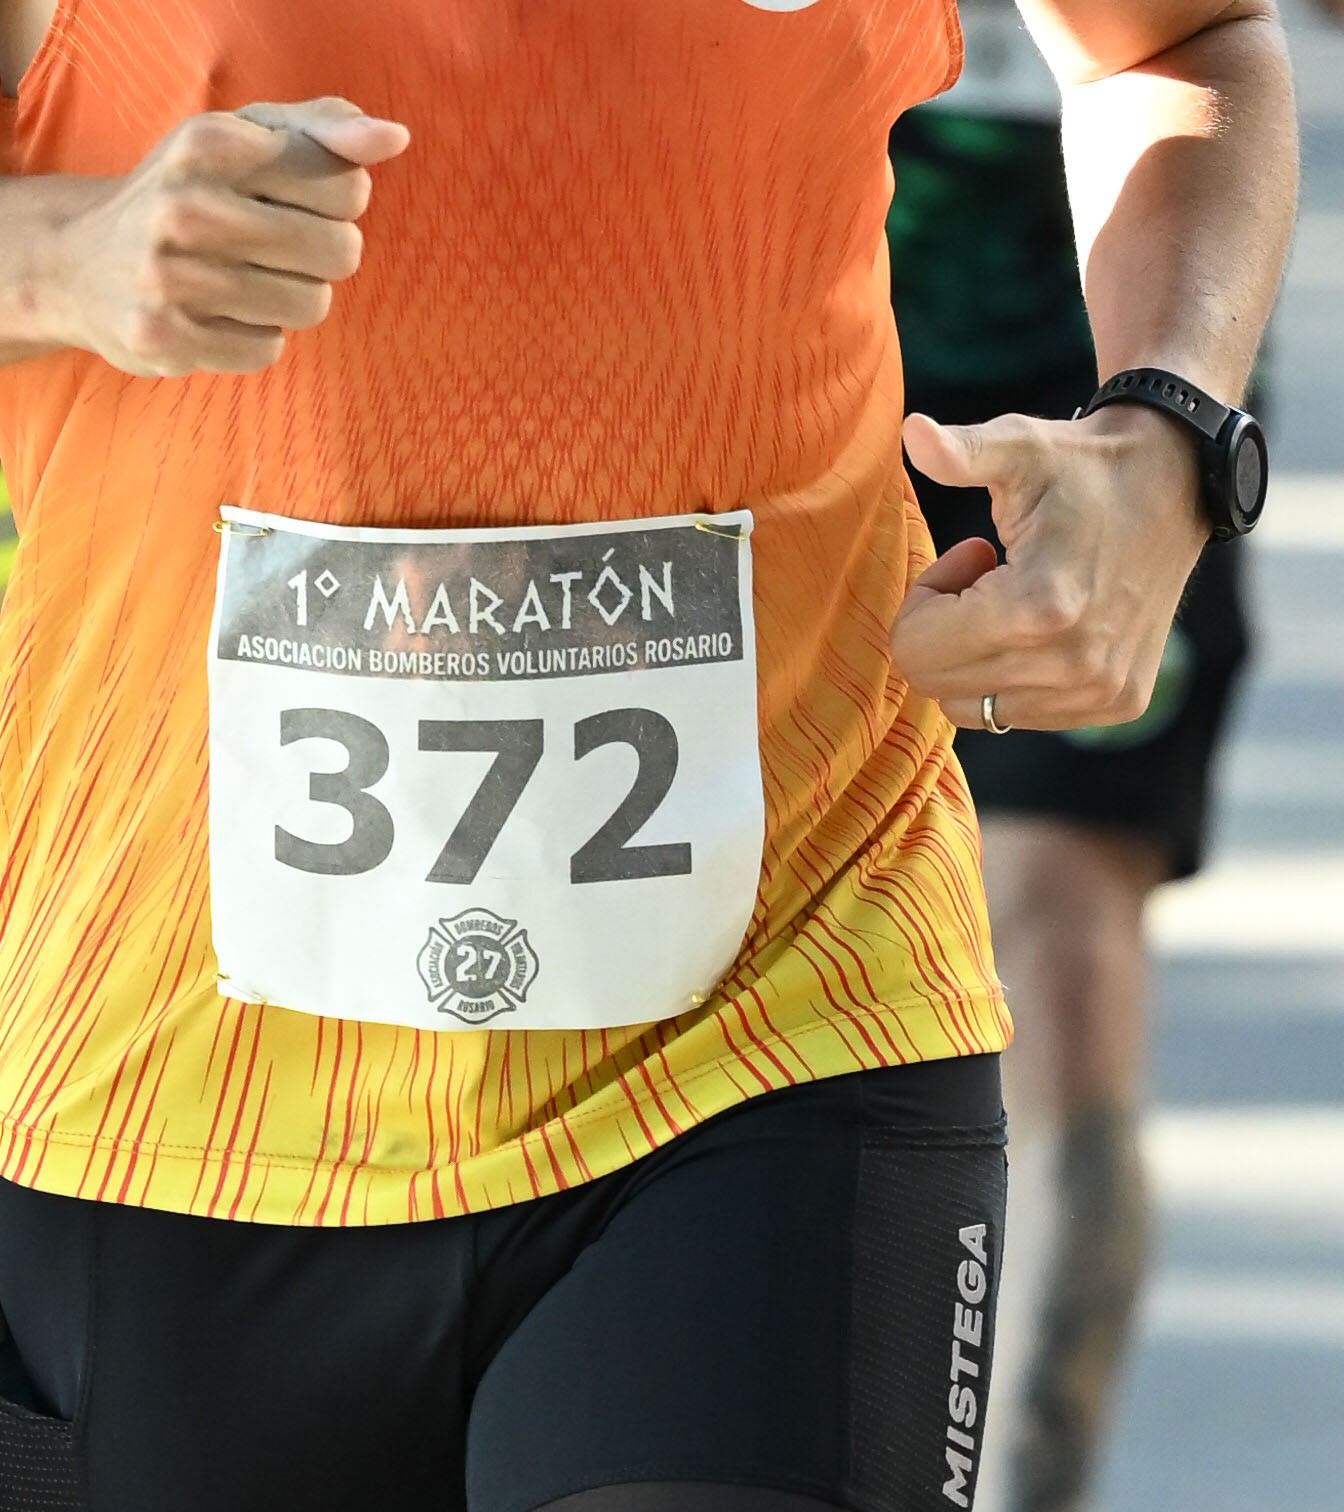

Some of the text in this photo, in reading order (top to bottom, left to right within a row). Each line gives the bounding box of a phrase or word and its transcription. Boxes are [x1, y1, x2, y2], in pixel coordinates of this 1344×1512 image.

[362, 547, 675, 636] MARATÓN
[369, 649, 491, 676] BOMBEROS
[496, 641, 638, 676] VOLUNTARIOS
[644, 631, 734, 664] ROSARIO
[273, 707, 692, 885] 372
[456, 944, 502, 982] 27
[941, 1223, 988, 1508] MISTEGA
